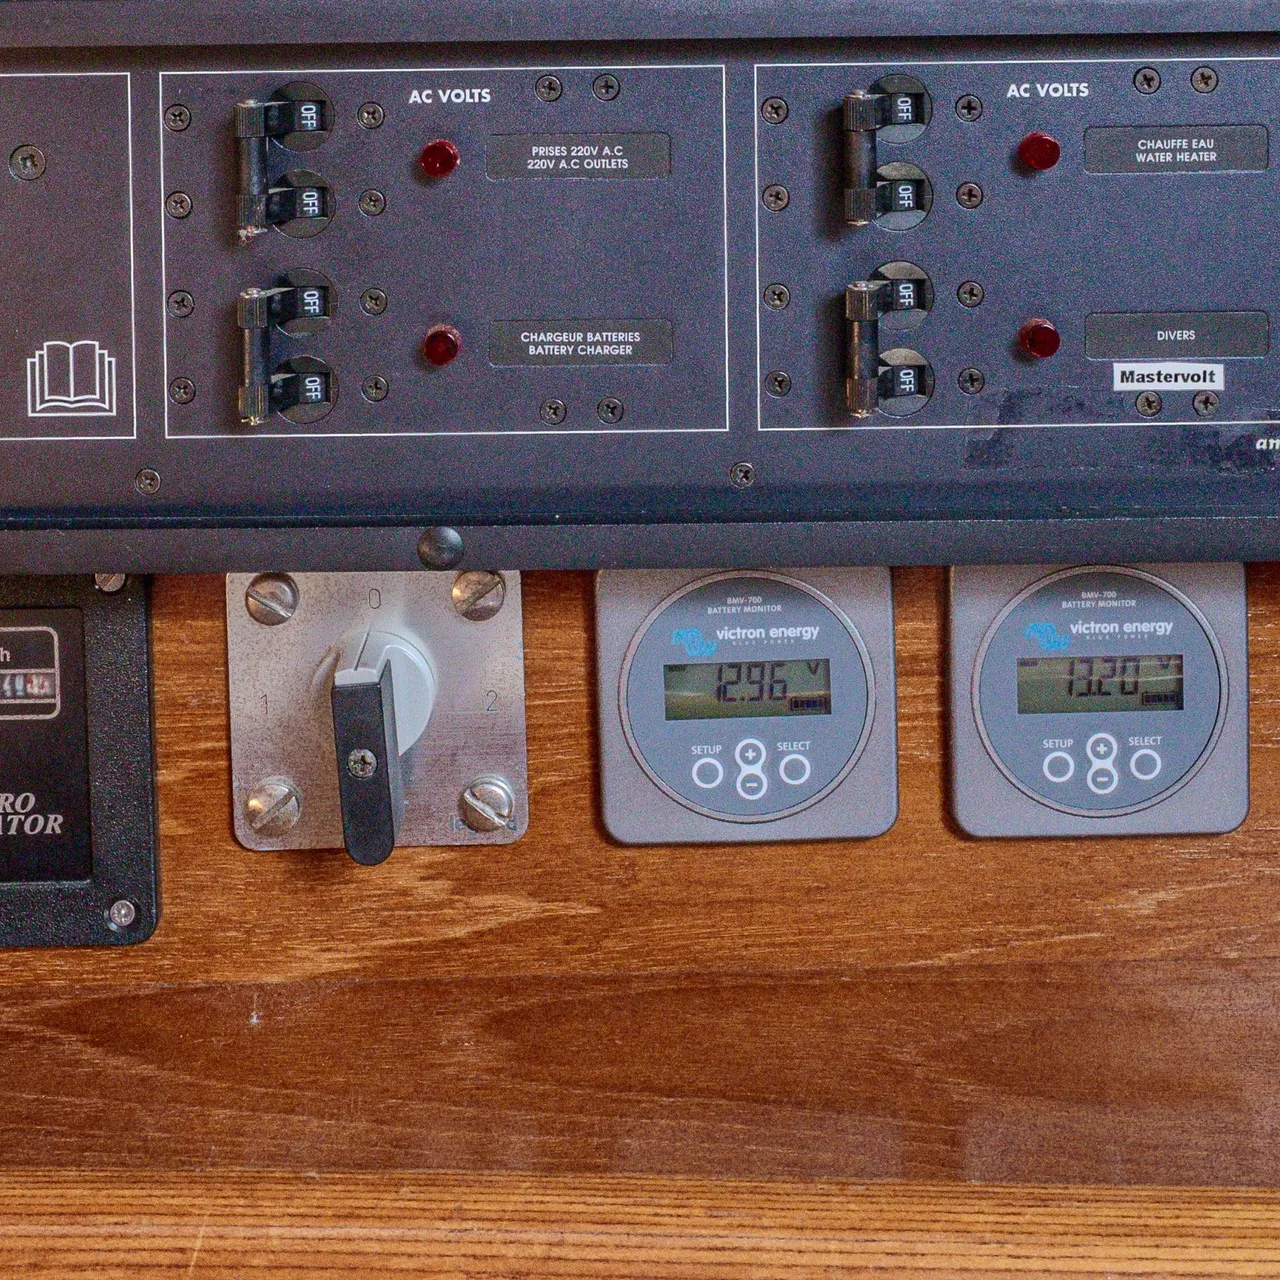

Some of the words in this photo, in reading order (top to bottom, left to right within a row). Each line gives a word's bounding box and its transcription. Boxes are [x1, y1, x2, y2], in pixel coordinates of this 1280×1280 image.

[410, 90, 432, 103] AC
[439, 89, 491, 103] VOLTS
[1007, 84, 1029, 97] AC
[1036, 83, 1089, 97] VOLTS
[302, 105, 316, 130] OFF
[532, 146, 567, 156] PRISES
[571, 146, 599, 156] 220V
[603, 146, 623, 156] A.C
[1138, 140, 1188, 150] CHAUFFE
[1192, 139, 1214, 149] EAU
[1136, 152, 1172, 162] WATER
[1177, 151, 1216, 161] HEATER
[528, 159, 555, 169] 220V
[560, 159, 579, 169] A.C
[584, 159, 628, 169] OUTLETS
[900, 283, 914, 307] OFF
[521, 332, 583, 343] CHARGEUR
[587, 332, 640, 342] BATTERIES
[1158, 330, 1195, 340] DIVERS
[529, 345, 573, 356] BATTERY
[577, 345, 632, 355] CHARGER
[1121, 370, 1215, 384] Mastervolt
[306, 376, 320, 400] OFF
[716, 627, 765, 639] victron
[770, 626, 819, 639] energy
[1070, 621, 1118, 633] victron
[1124, 621, 1173, 634] energy
[807, 662, 819, 675] V
[487, 690, 497, 711] 2
